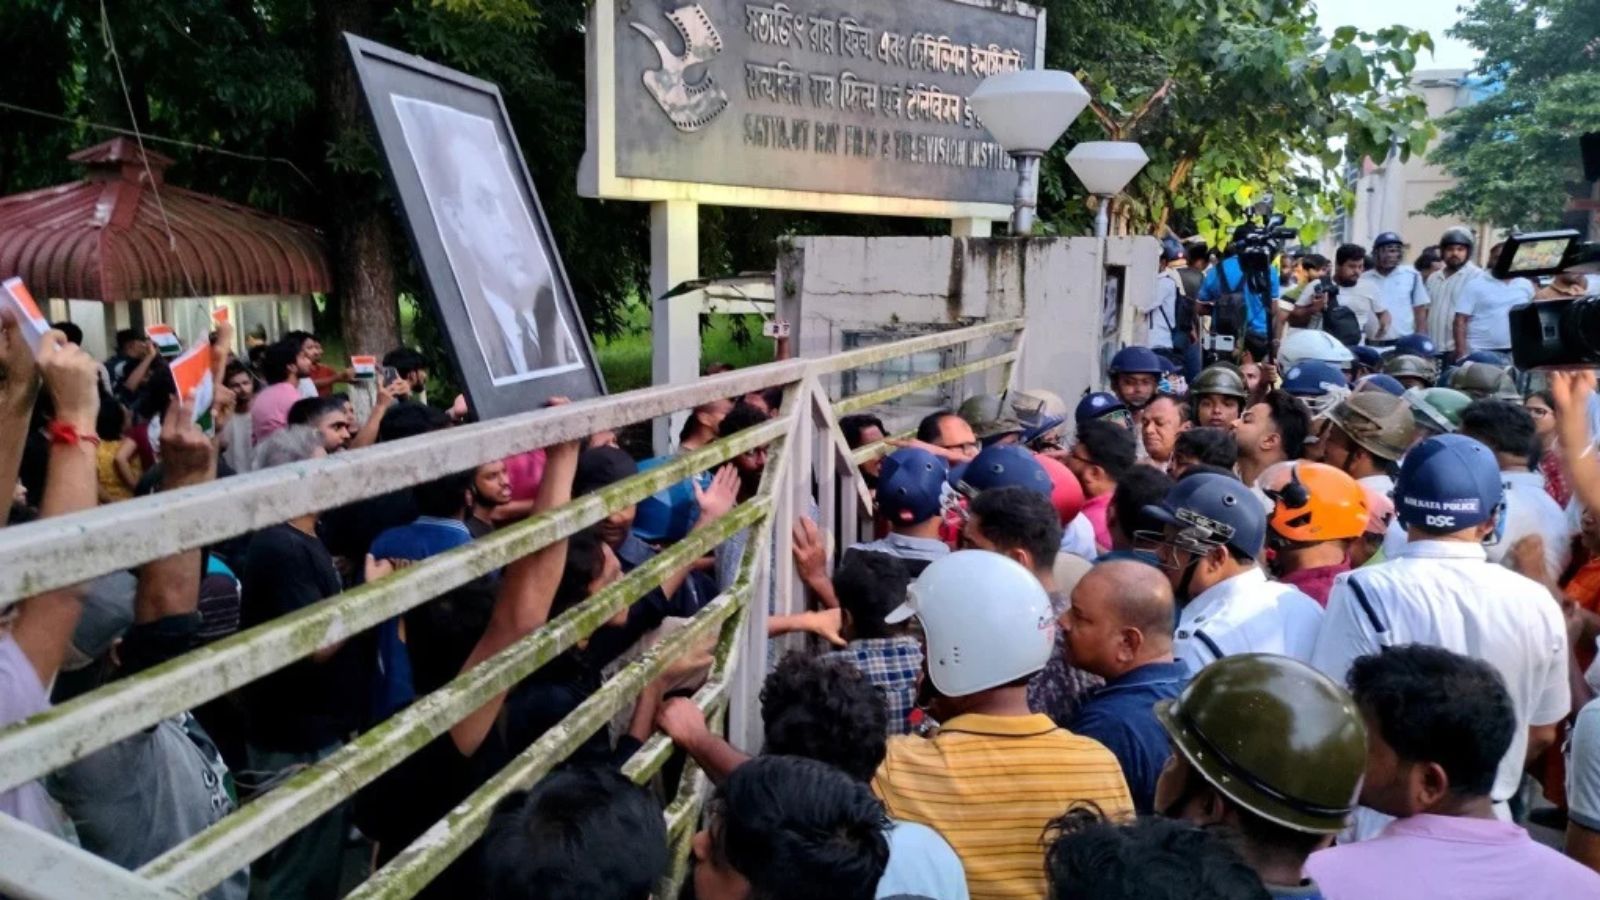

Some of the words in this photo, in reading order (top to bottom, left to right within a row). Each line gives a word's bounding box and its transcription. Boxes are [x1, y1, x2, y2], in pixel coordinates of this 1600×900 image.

[743, 112, 809, 152] SATYAJIT
[814, 121, 840, 155] RAY
[894, 131, 966, 167] TELEVISION
[1443, 502, 1478, 512] POLICE
[1426, 515, 1456, 527] DSC
